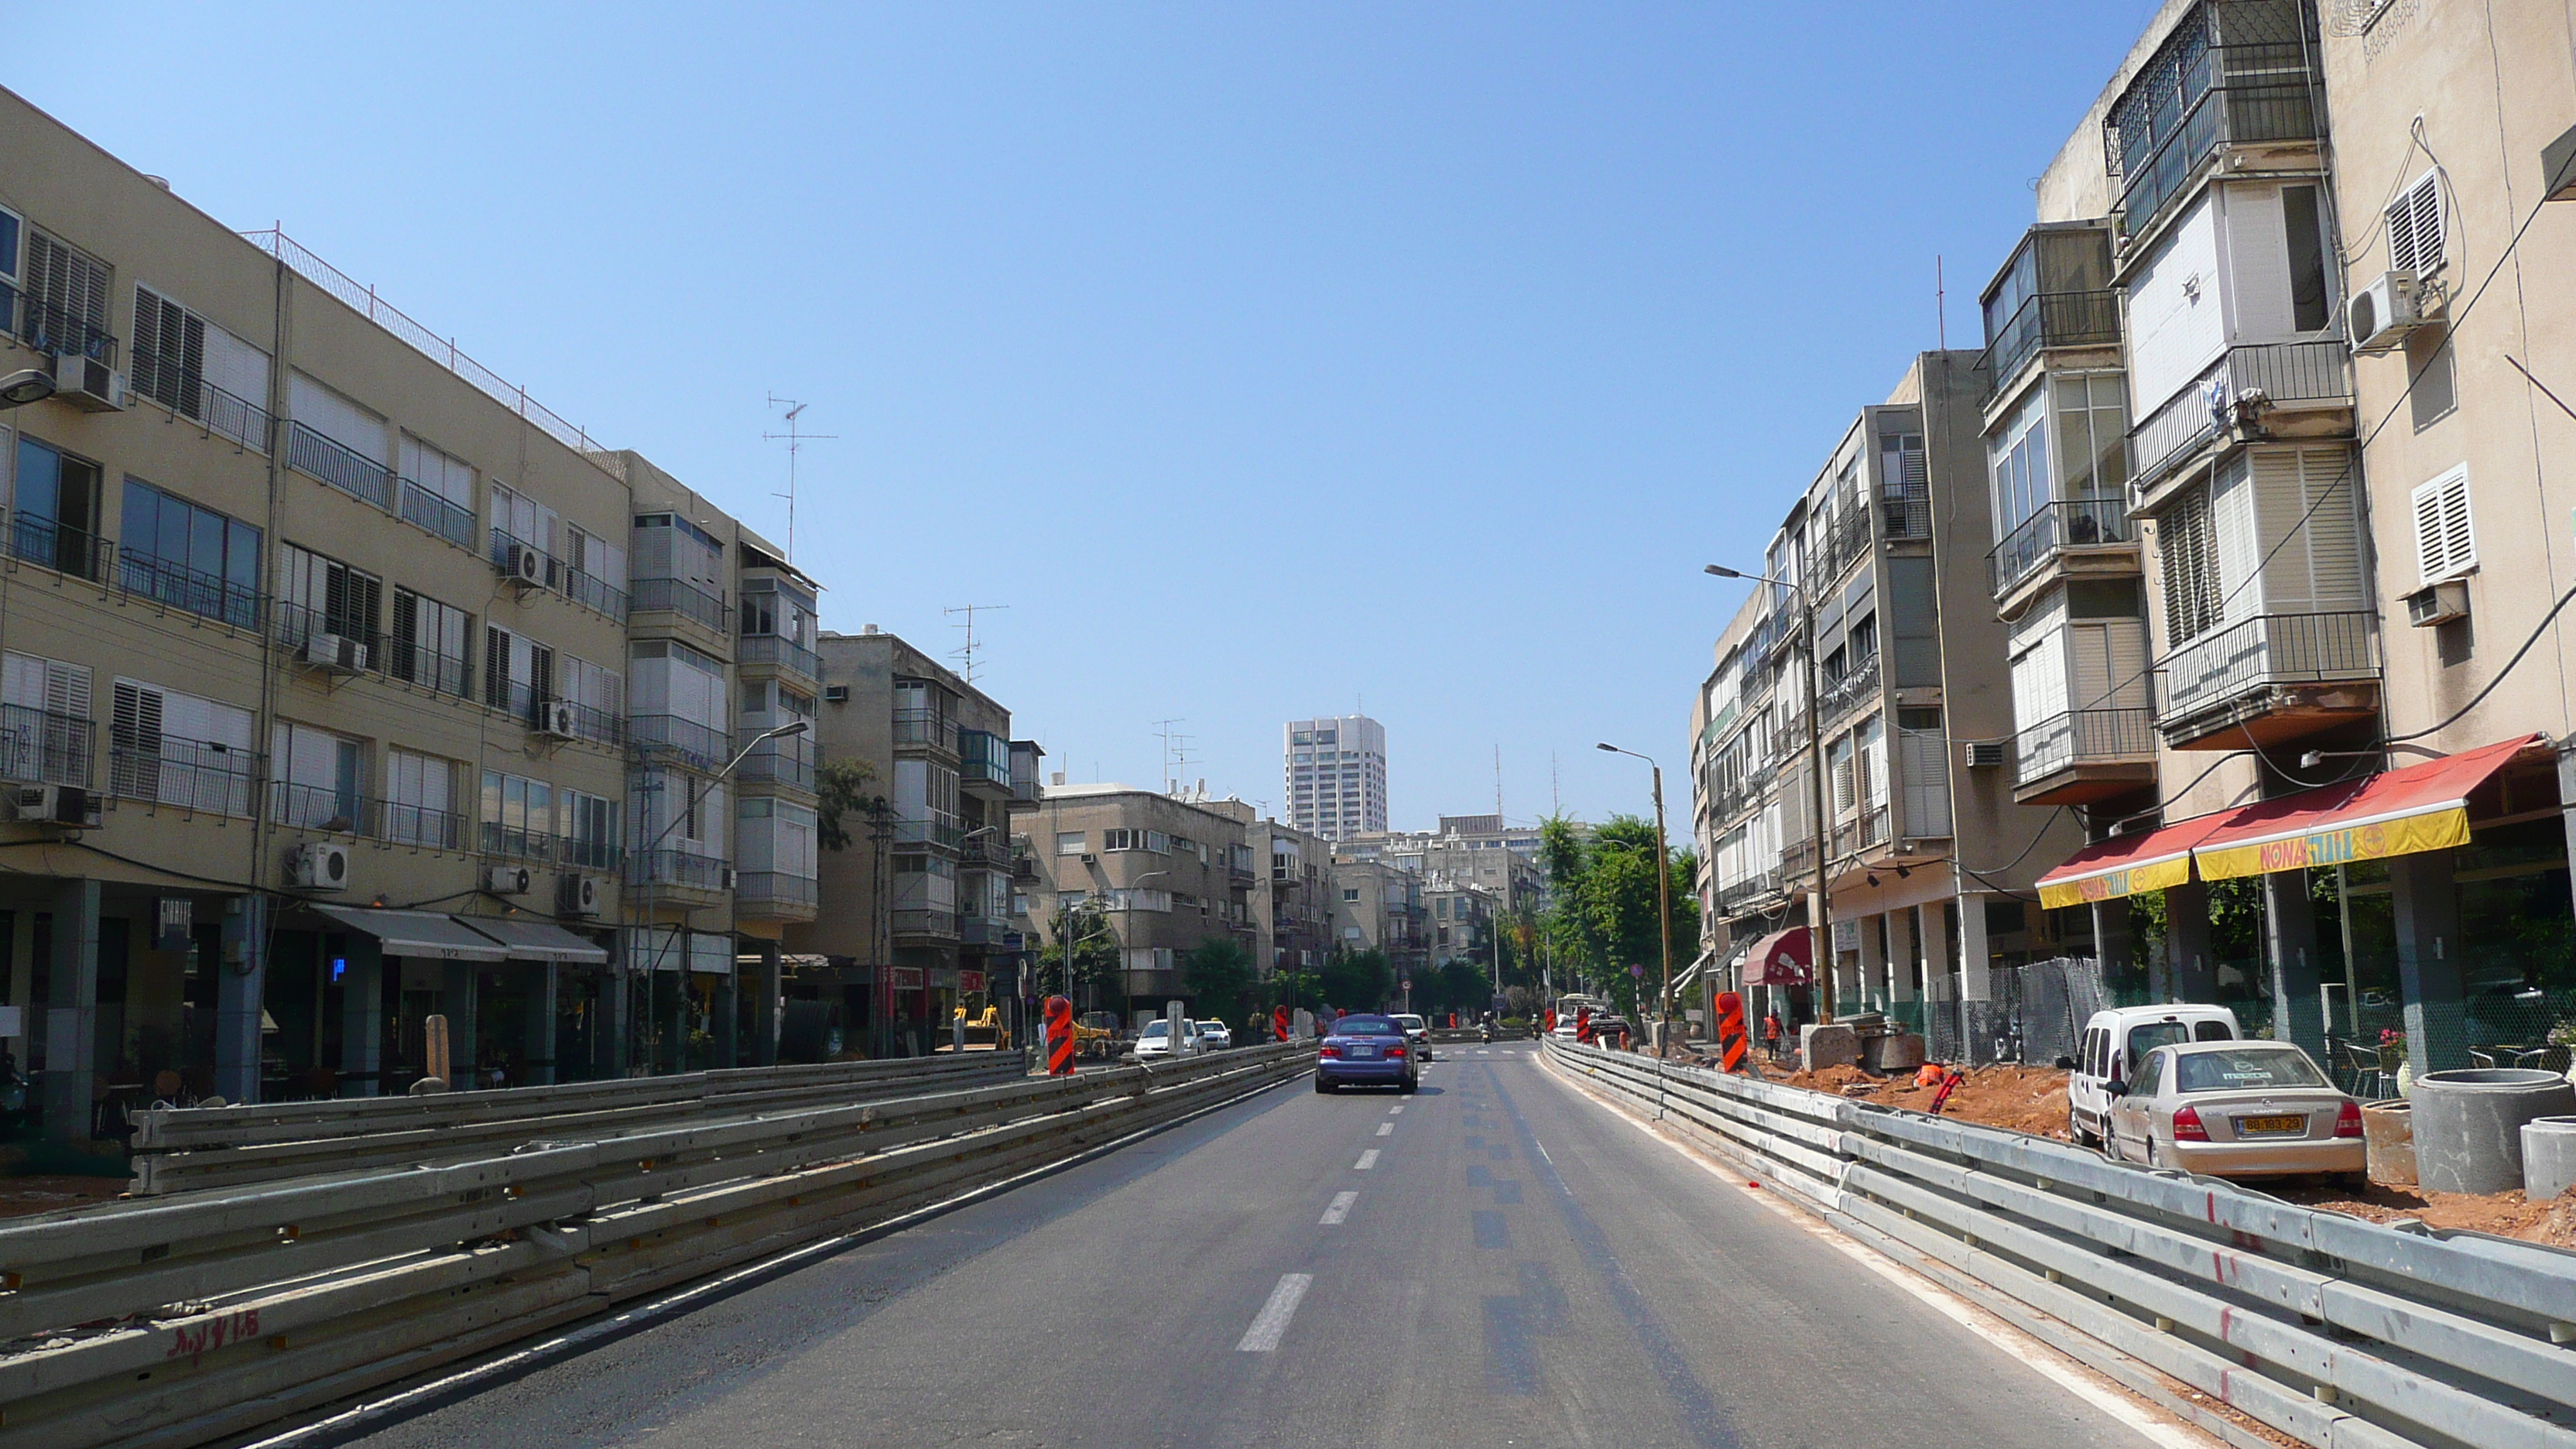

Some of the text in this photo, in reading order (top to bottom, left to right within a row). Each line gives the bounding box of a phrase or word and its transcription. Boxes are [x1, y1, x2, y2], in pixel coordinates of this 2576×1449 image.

[2260, 838, 2307, 871] NONA
[2308, 831, 2353, 864] נונה
[2078, 875, 2109, 901] NONA
[2222, 1071, 2273, 1080] mazda
